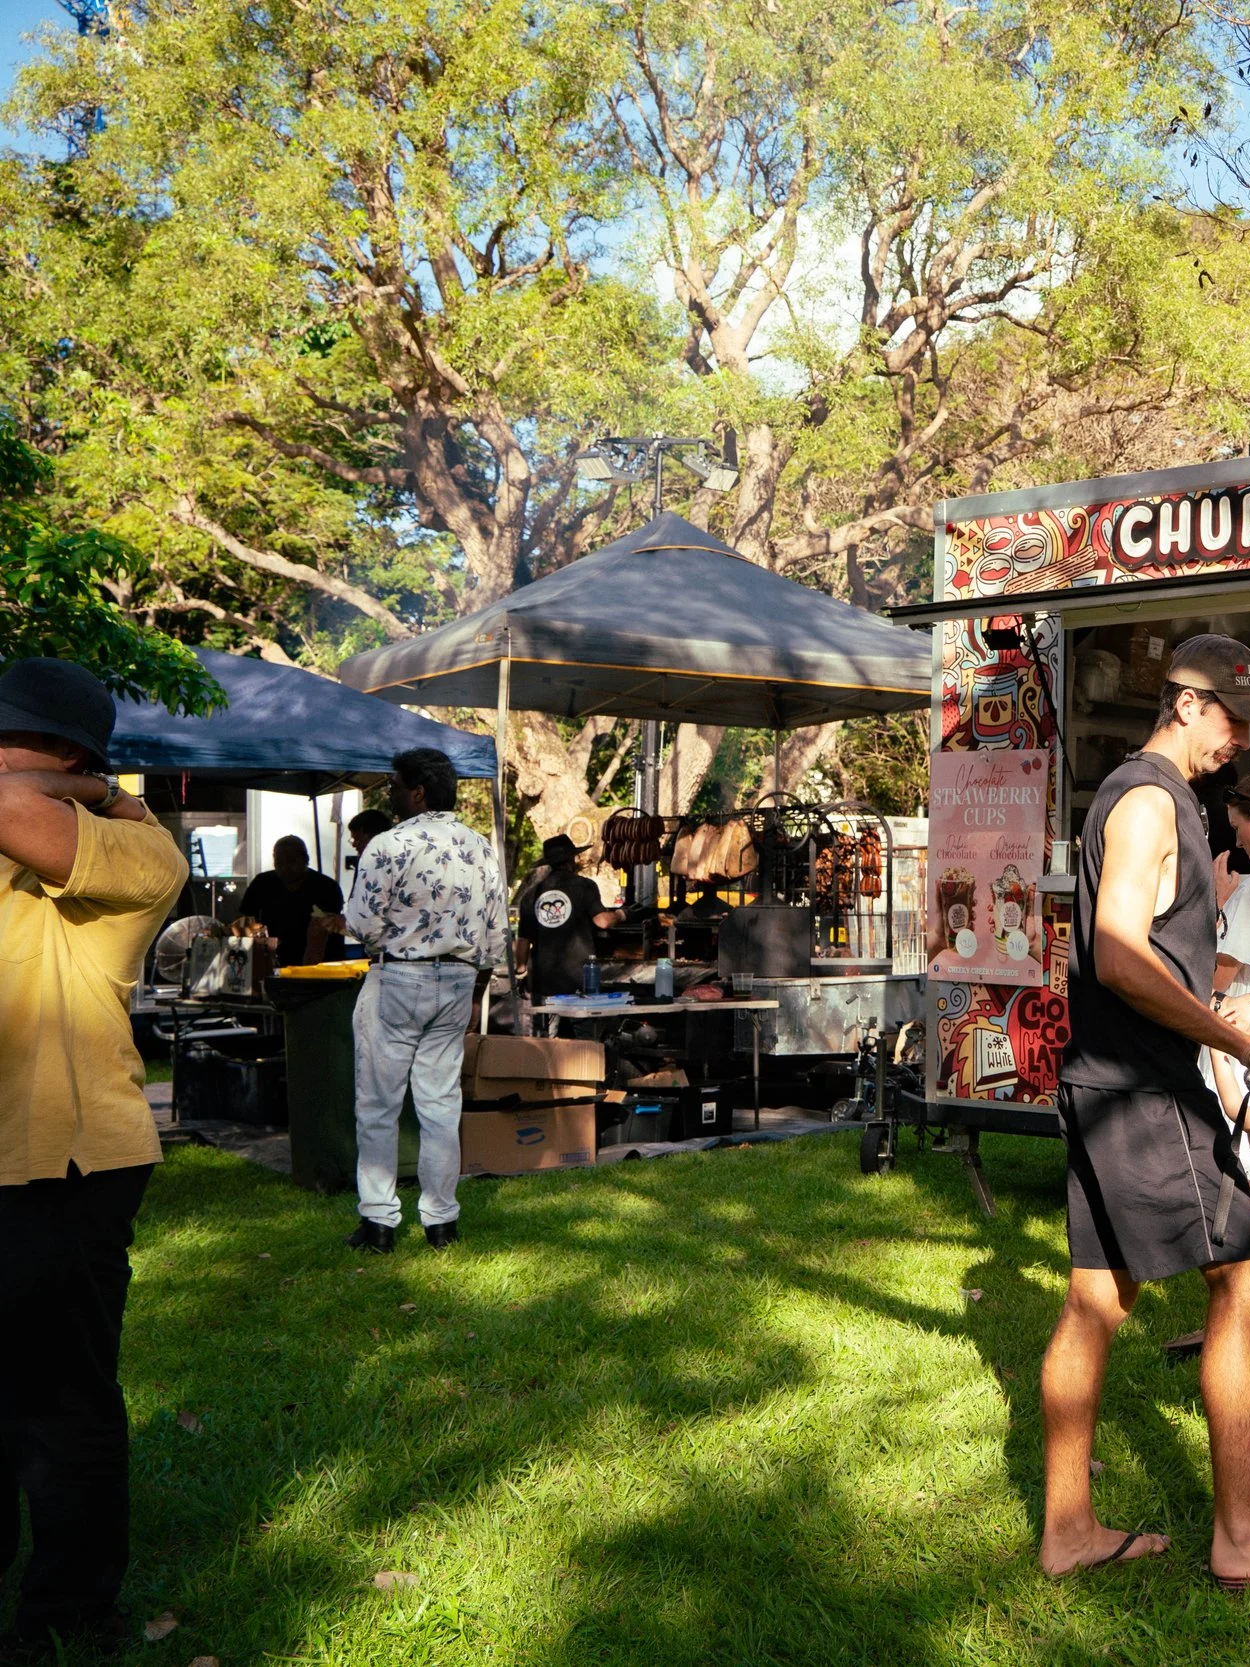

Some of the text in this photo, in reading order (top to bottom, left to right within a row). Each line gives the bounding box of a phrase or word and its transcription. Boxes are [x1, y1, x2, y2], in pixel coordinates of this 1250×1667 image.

[956, 764, 1012, 797] Chocolate
[933, 786, 1043, 806] STRAWBERRY
[964, 807, 1006, 826] CUPS
[996, 835, 1031, 854] Original
[936, 849, 977, 860] Chocolate
[989, 849, 1035, 861] Chocolate
[1054, 959, 1068, 979] MIL
[987, 1051, 1013, 1069] WHITE
